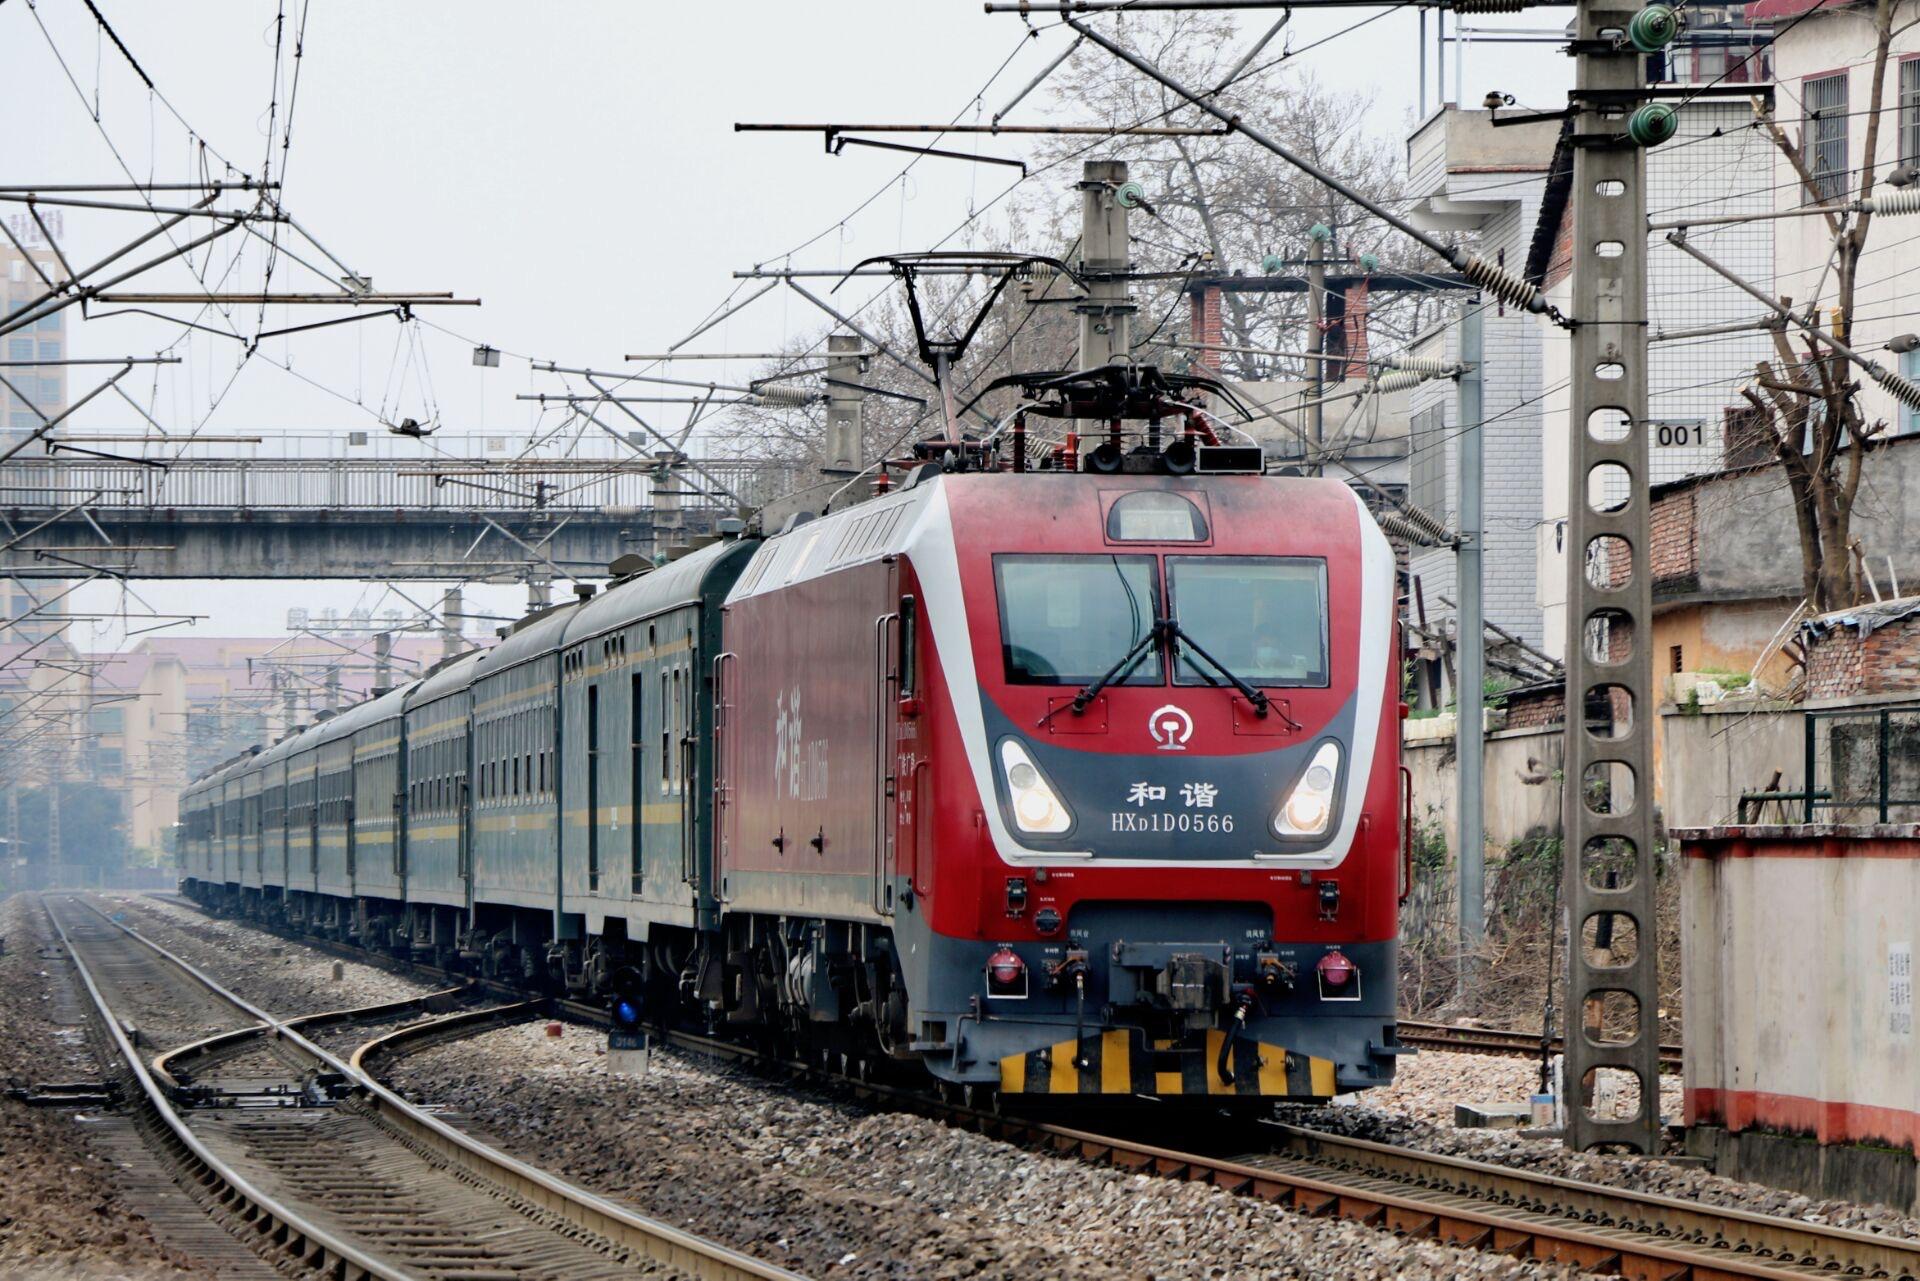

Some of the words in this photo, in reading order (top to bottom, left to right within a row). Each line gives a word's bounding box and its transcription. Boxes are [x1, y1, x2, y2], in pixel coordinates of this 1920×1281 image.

[1658, 425, 1702, 446] 001
[1126, 782, 1219, 808] 和谐
[1112, 813, 1233, 833] HXD1D0566
